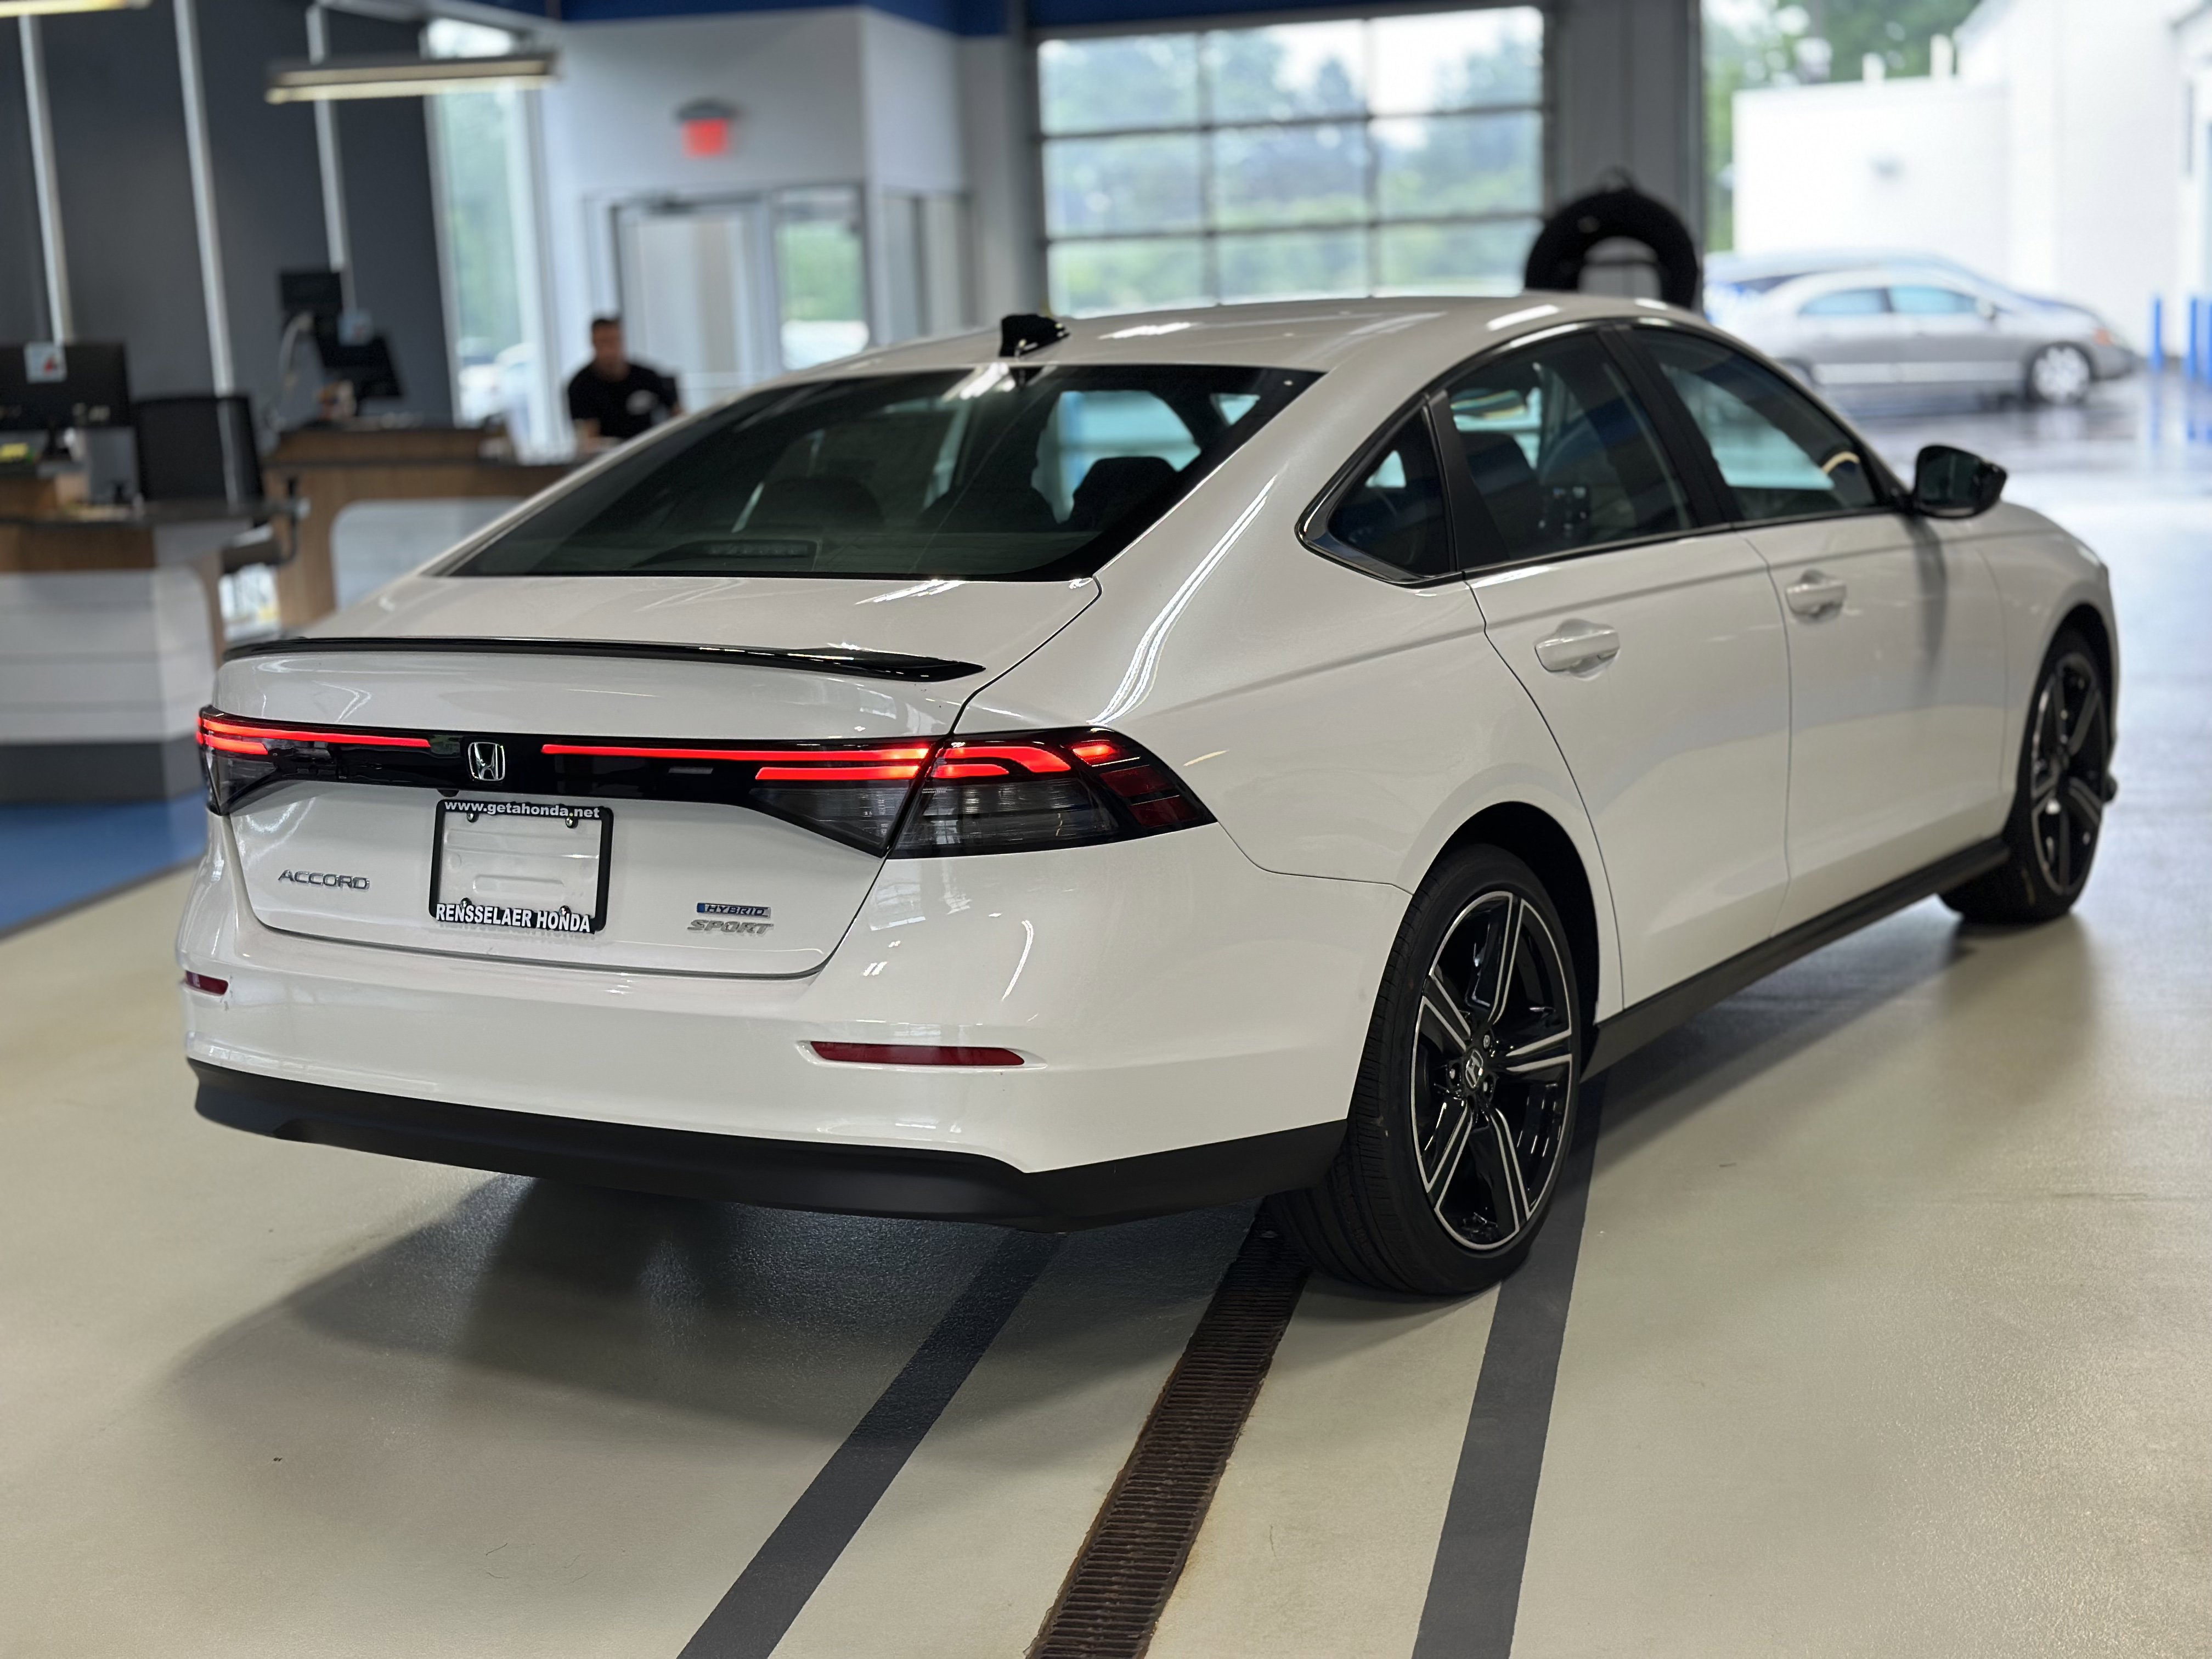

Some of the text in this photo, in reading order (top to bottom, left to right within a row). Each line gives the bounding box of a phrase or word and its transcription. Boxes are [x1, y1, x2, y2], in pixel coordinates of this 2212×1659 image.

[444, 801, 600, 818] www.getahonda.net
[278, 870, 370, 889] ACCORD
[436, 904, 590, 933] RENSSELAER HONDA
[707, 905, 765, 916] HYBRID
[687, 919, 774, 934] SPORT
